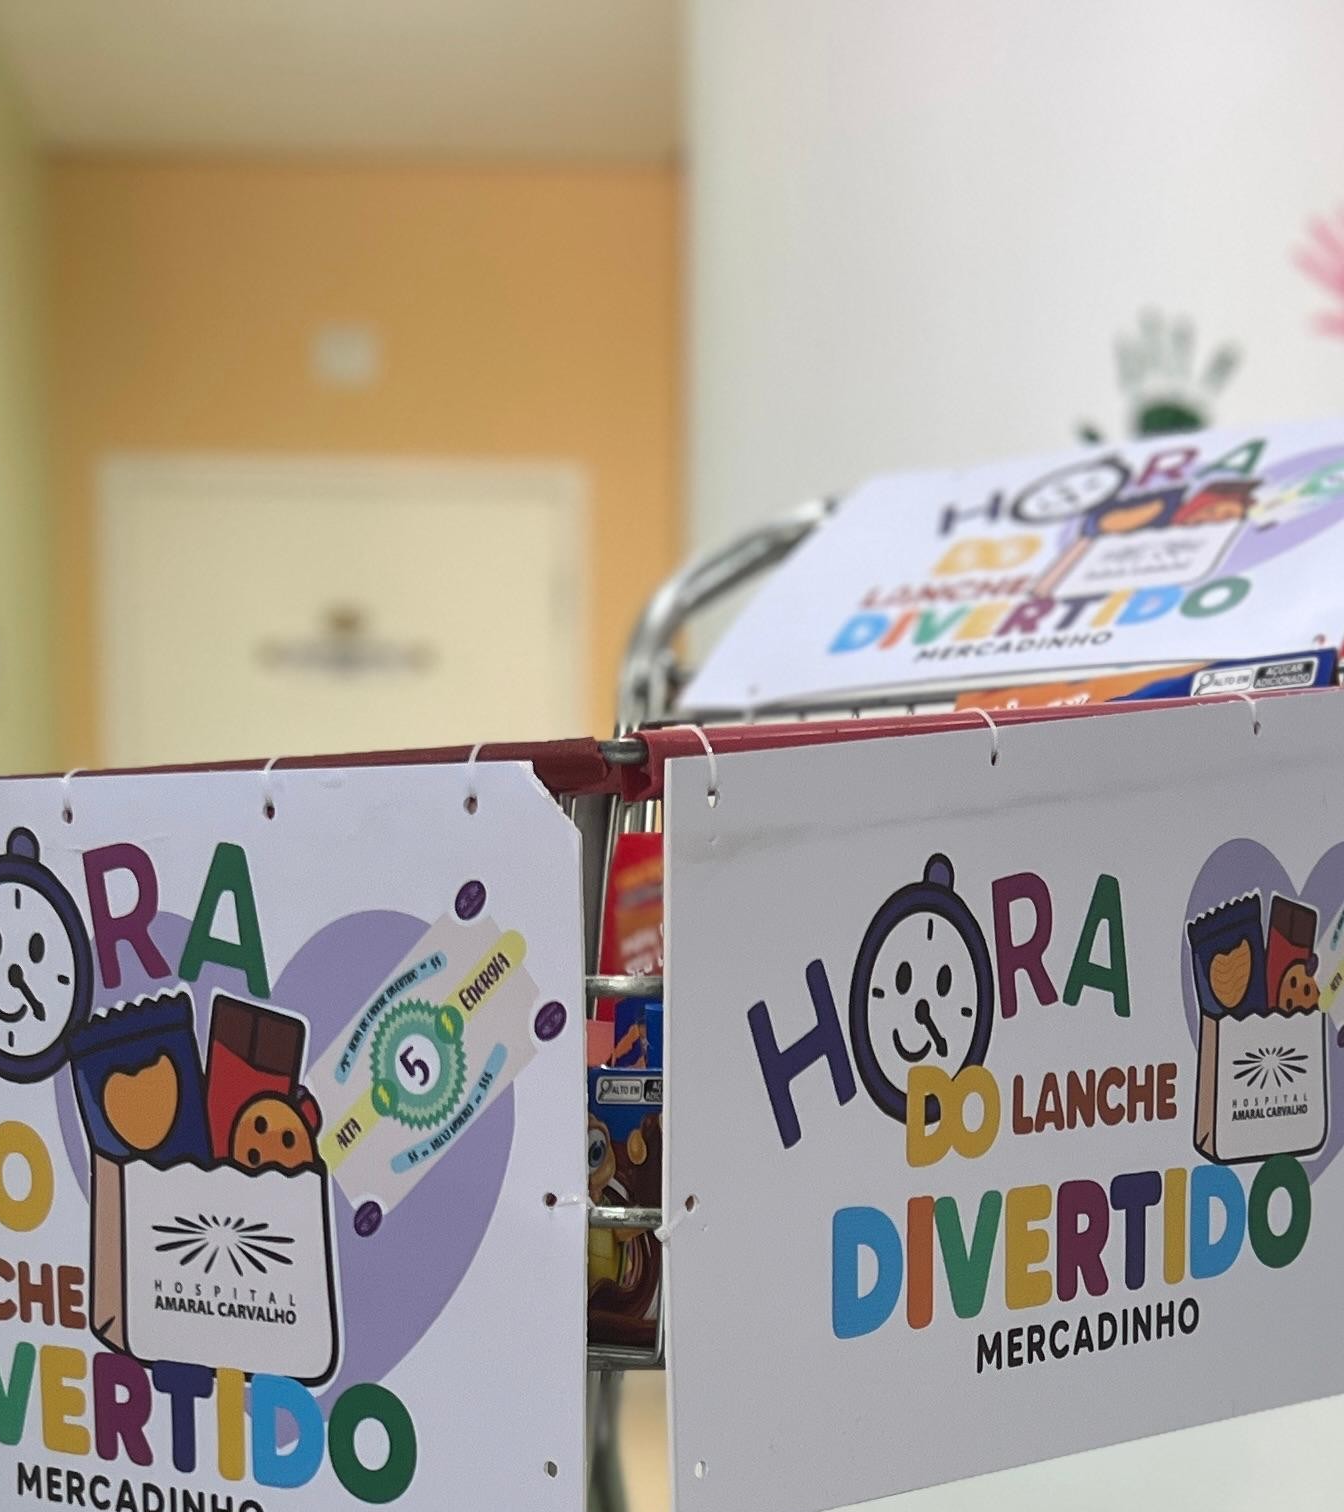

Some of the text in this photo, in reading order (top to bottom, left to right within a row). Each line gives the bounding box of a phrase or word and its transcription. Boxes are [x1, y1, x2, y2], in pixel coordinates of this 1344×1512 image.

[827, 576, 1252, 655] DIVERTIDO
[747, 852, 1131, 1150] HORA
[399, 1046, 430, 1087] 5
[905, 1062, 1177, 1167] DO LANCHE
[831, 1154, 1312, 1340] DIVERTIDO
[154, 1279, 296, 1307] HOSPITAL
[155, 1295, 297, 1325] AMARAL CARVALHO
[975, 1296, 1201, 1373] MERCADINHO
